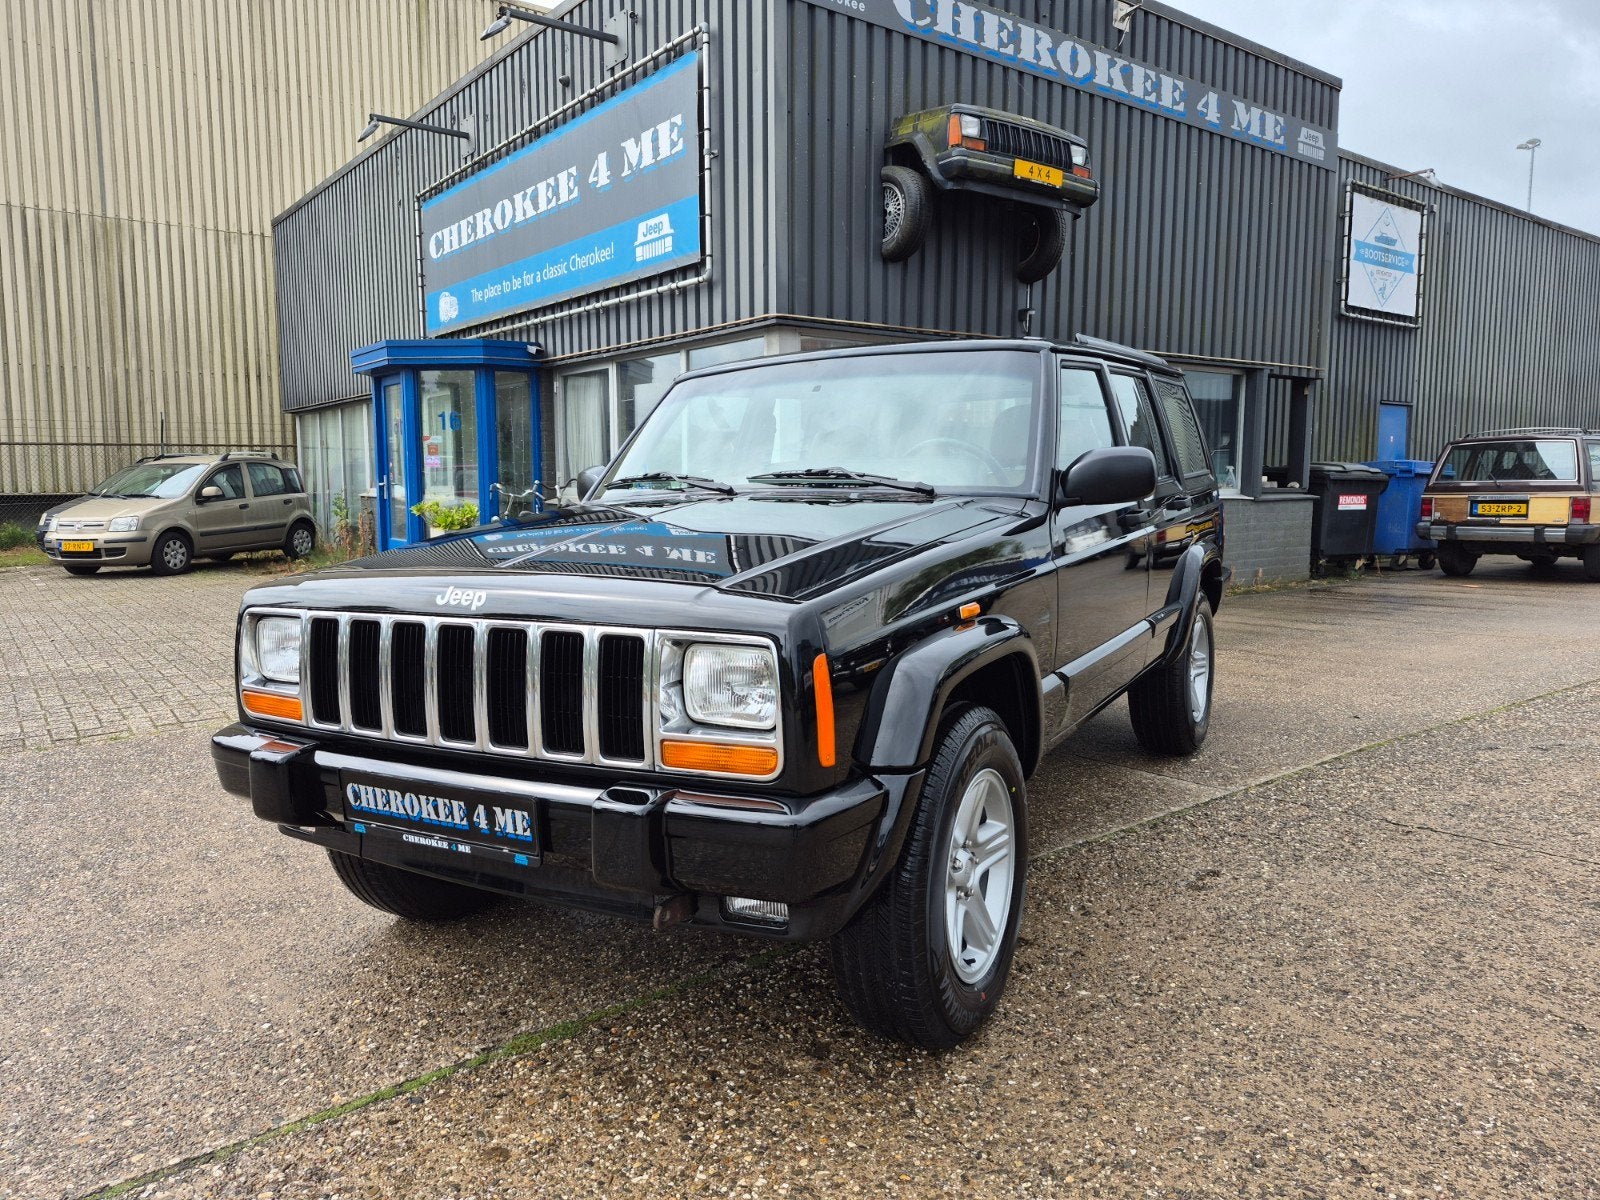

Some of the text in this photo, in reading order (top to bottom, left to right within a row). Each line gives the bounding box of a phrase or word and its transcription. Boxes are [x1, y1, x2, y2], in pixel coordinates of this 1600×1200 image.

[893, 0, 1286, 148] CHEROKEE 4 ME
[1303, 130, 1321, 146] Jeep
[1028, 165, 1034, 176] 4
[1045, 169, 1051, 181] 4
[428, 113, 686, 261] CHEROKEE 4 ME
[642, 219, 664, 238] Jeep
[1364, 248, 1406, 266] BOOTSERVICE
[471, 242, 615, 303] The place to be for a classic Cherokee!
[438, 410, 462, 431] 16
[1481, 504, 1522, 513] 53-ZRP-2
[436, 586, 488, 611] Jeep
[346, 782, 533, 841] CHEROKEE 4 ME
[402, 833, 472, 854] CHEROKEE 4 ME
